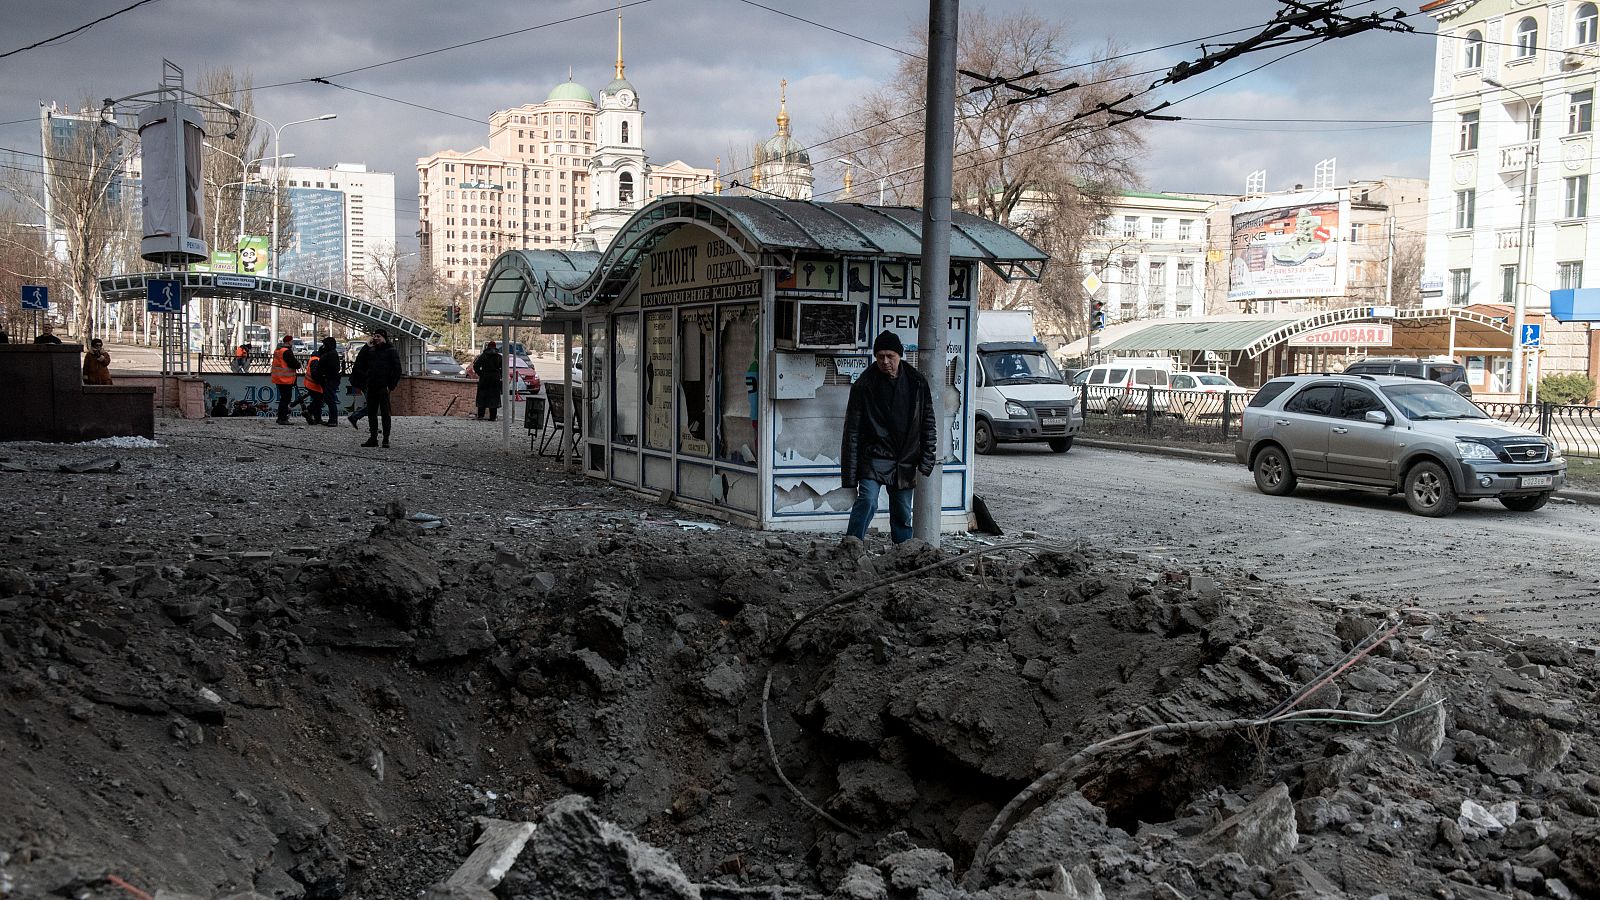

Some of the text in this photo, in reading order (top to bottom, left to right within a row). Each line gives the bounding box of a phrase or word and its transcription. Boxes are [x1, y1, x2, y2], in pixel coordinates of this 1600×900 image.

[650, 245, 698, 288] РЕМОНТ
[706, 260, 752, 283] ОДЕЖДЫ
[643, 281, 760, 306] ИЗГОТОВЛЕНИЕ КЛЮЧЕЙ
[1306, 329, 1376, 342] СТОЛОВАЯ
[837, 359, 868, 368] ФУРНИТУРЫ
[1208, 352, 1229, 360] СТОП
